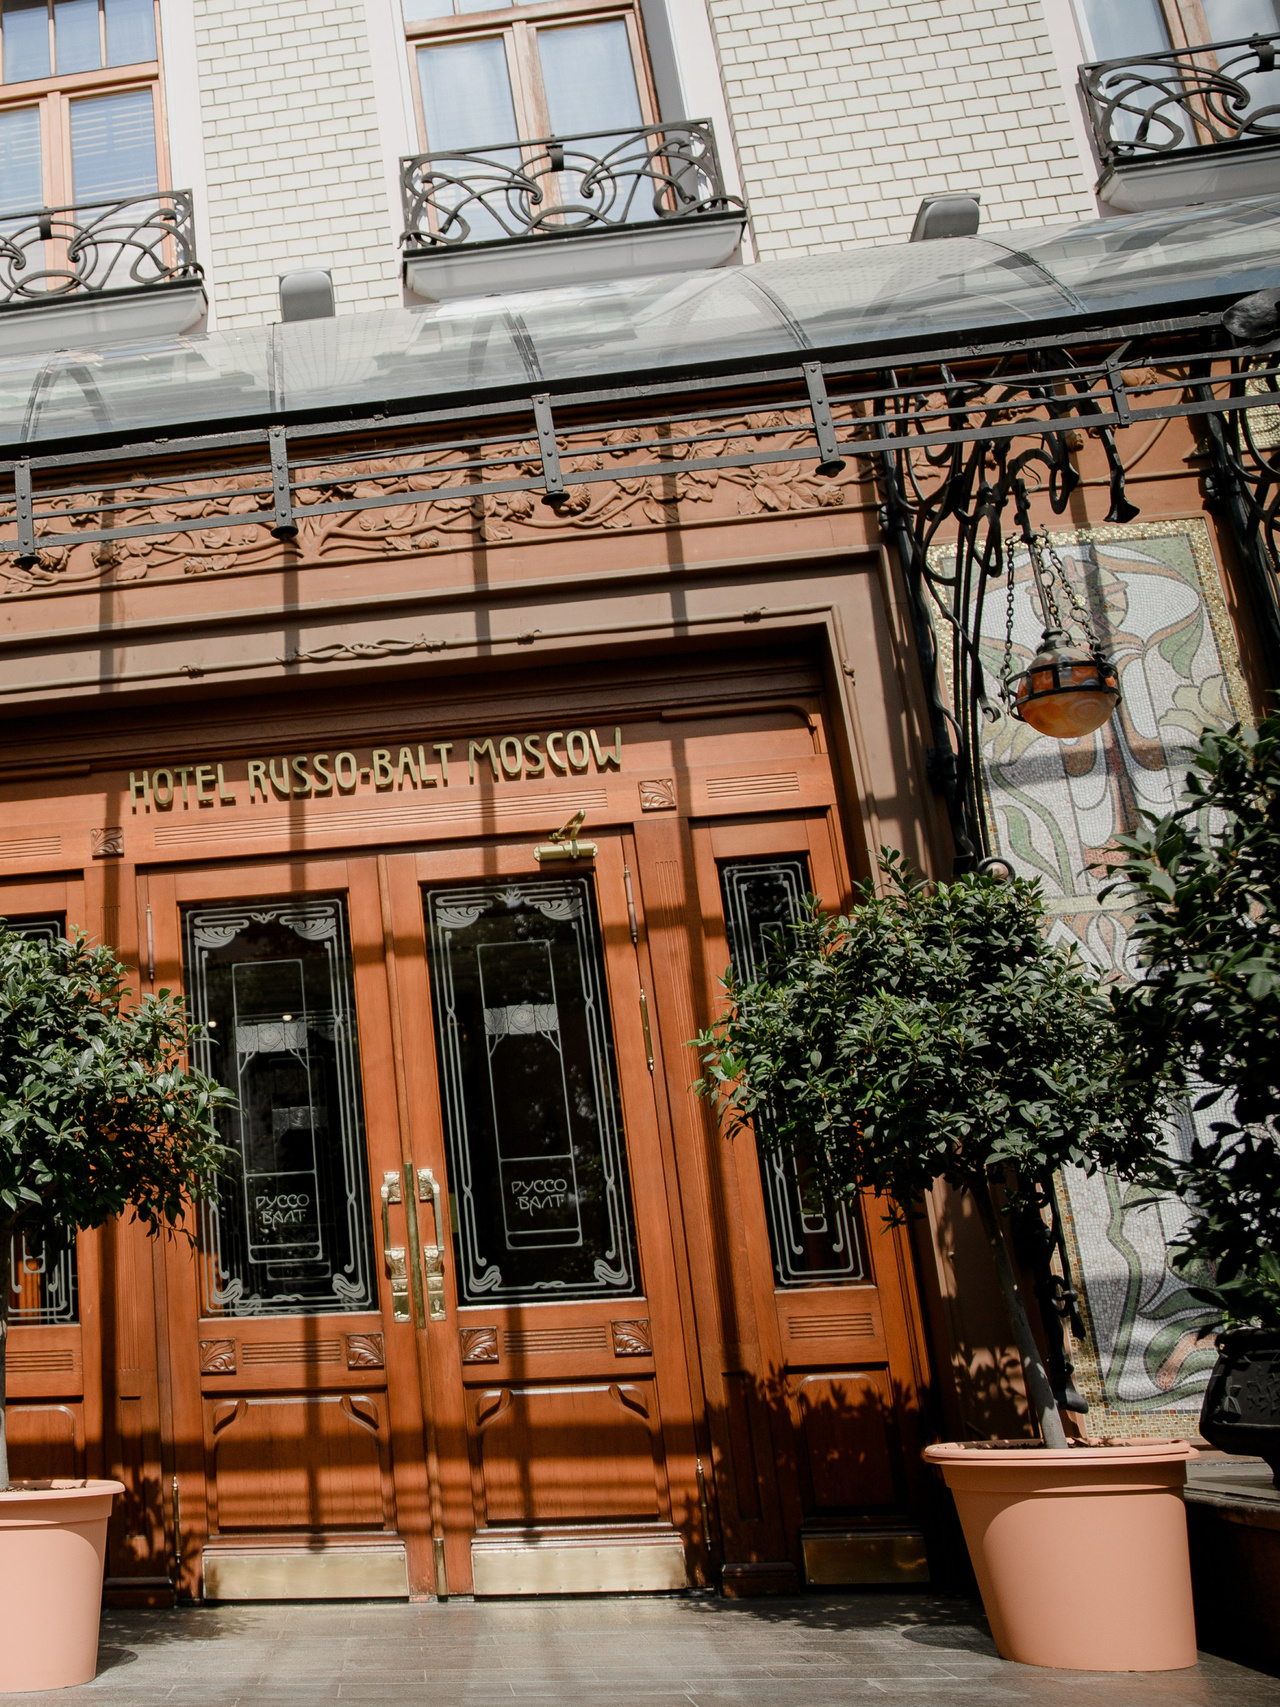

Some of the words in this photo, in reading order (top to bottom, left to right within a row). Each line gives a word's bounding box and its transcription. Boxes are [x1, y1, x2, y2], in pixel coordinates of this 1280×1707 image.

[129, 763, 237, 807] HOTEL
[247, 743, 454, 797] RUSSO-BALT
[468, 727, 622, 778] MOSCOW
[511, 1178, 568, 1195] РУССО
[255, 1193, 310, 1210] РУССО
